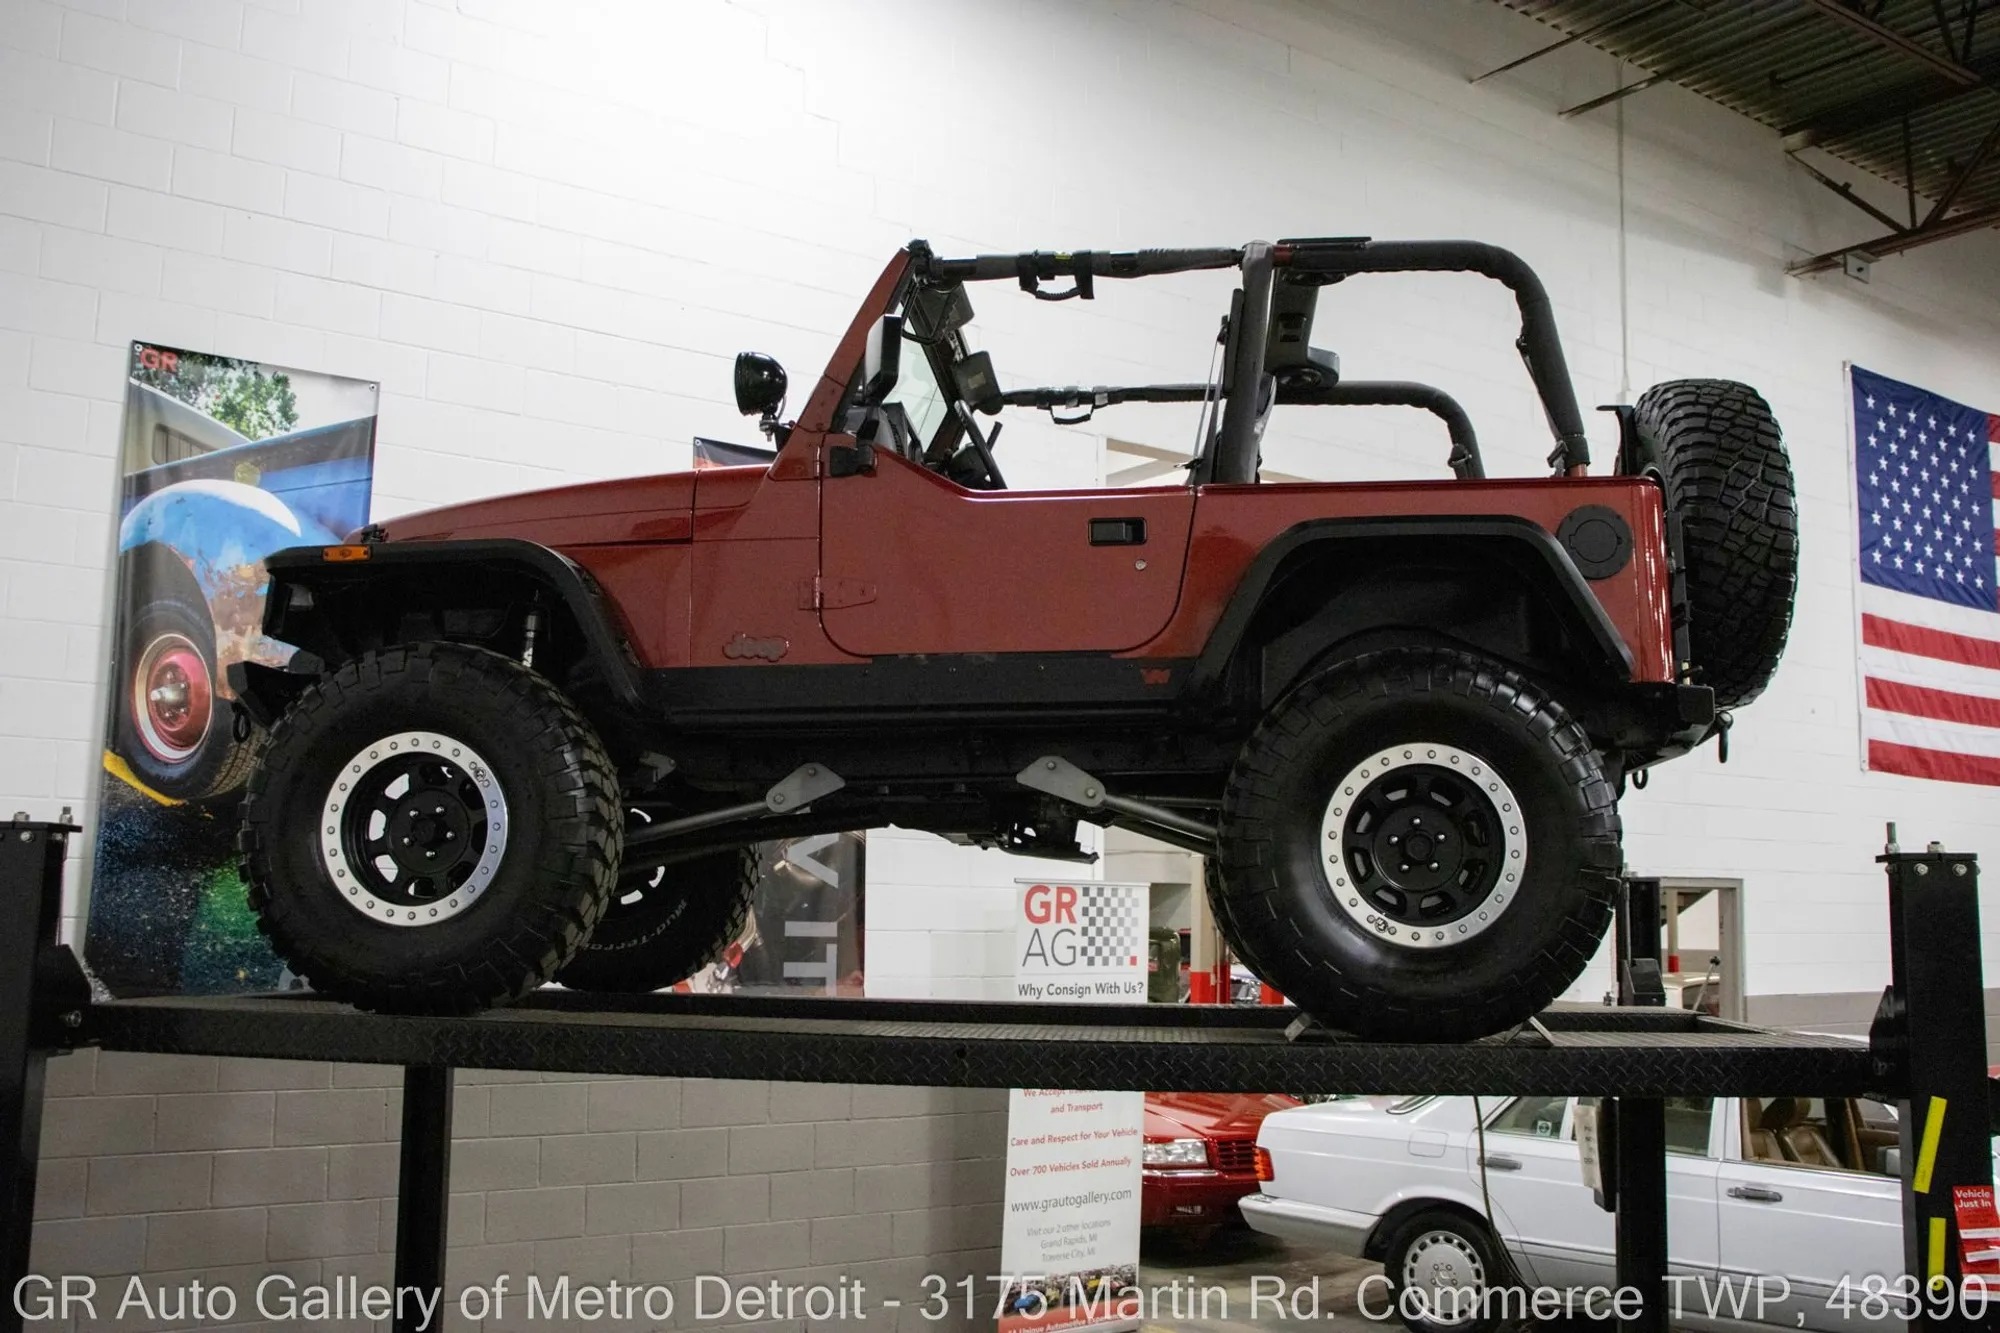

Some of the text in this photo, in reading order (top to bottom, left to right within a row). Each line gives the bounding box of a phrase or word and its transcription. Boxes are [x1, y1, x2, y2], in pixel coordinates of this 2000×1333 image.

[140, 348, 178, 372] GR
[1024, 884, 1077, 924] GR
[1022, 928, 1076, 967] AG
[1018, 981, 1144, 999] Why Consign With Us?
[1050, 1102, 1103, 1114] and Transport
[1010, 1127, 1138, 1147] Care and Respect for Your Vehicle
[1010, 1156, 1132, 1177] Over 700 Vehicles Sold Annually
[1011, 1188, 1132, 1213] www.grautogallery.com
[1955, 1189, 1990, 1198] Vehicle
[1959, 1199, 1992, 1208] Just In
[1056, 1224, 1061, 1233] 2
[1062, 1222, 1079, 1232] other
[1081, 1219, 1111, 1230] locations
[1041, 1238, 1062, 1249] Grand
